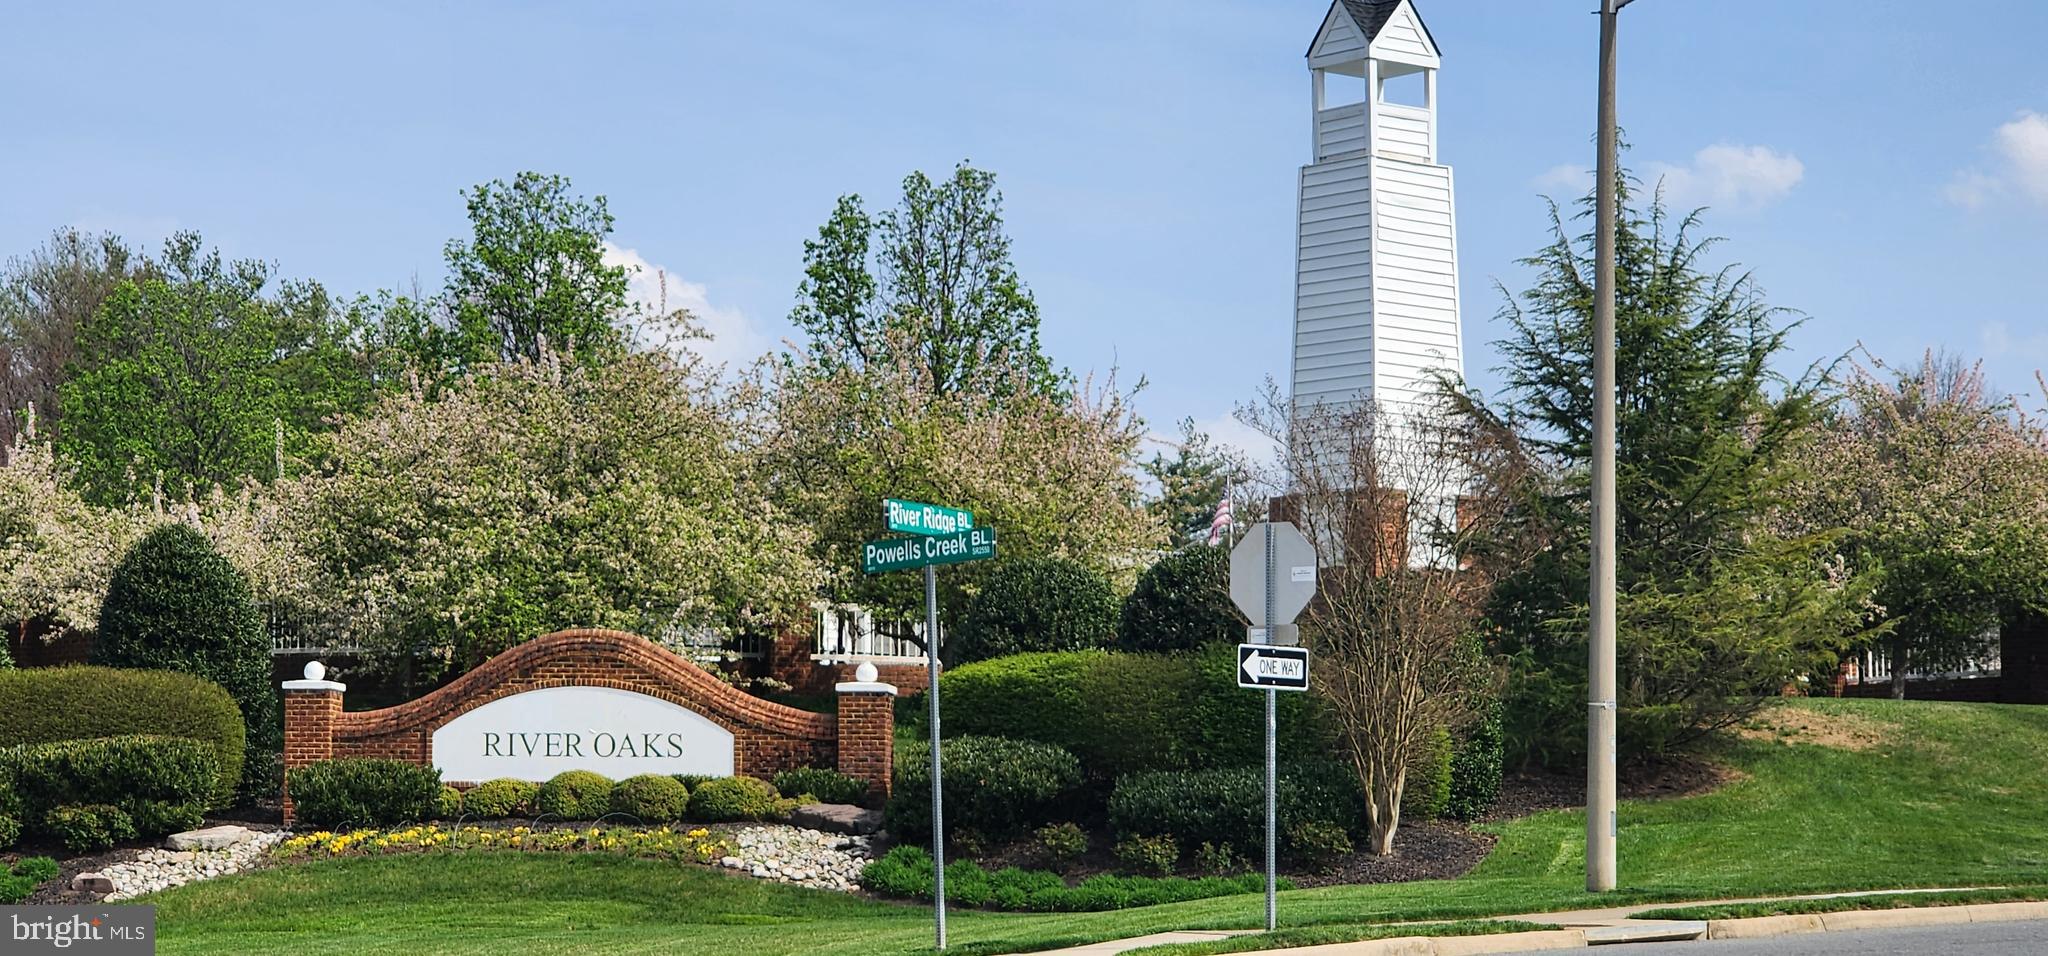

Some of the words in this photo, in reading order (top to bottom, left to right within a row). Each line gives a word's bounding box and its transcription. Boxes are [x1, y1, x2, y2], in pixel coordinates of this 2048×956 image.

[890, 501, 921, 527] River
[923, 506, 956, 534] Ridge
[957, 512, 972, 529] BL
[866, 540, 921, 566] Powells
[925, 533, 968, 558] Creek
[971, 530, 989, 546] BL
[1259, 659, 1278, 674] ONE
[1281, 661, 1300, 676] WAY
[482, 732, 585, 757] RIVER
[593, 732, 683, 758] OAKS
